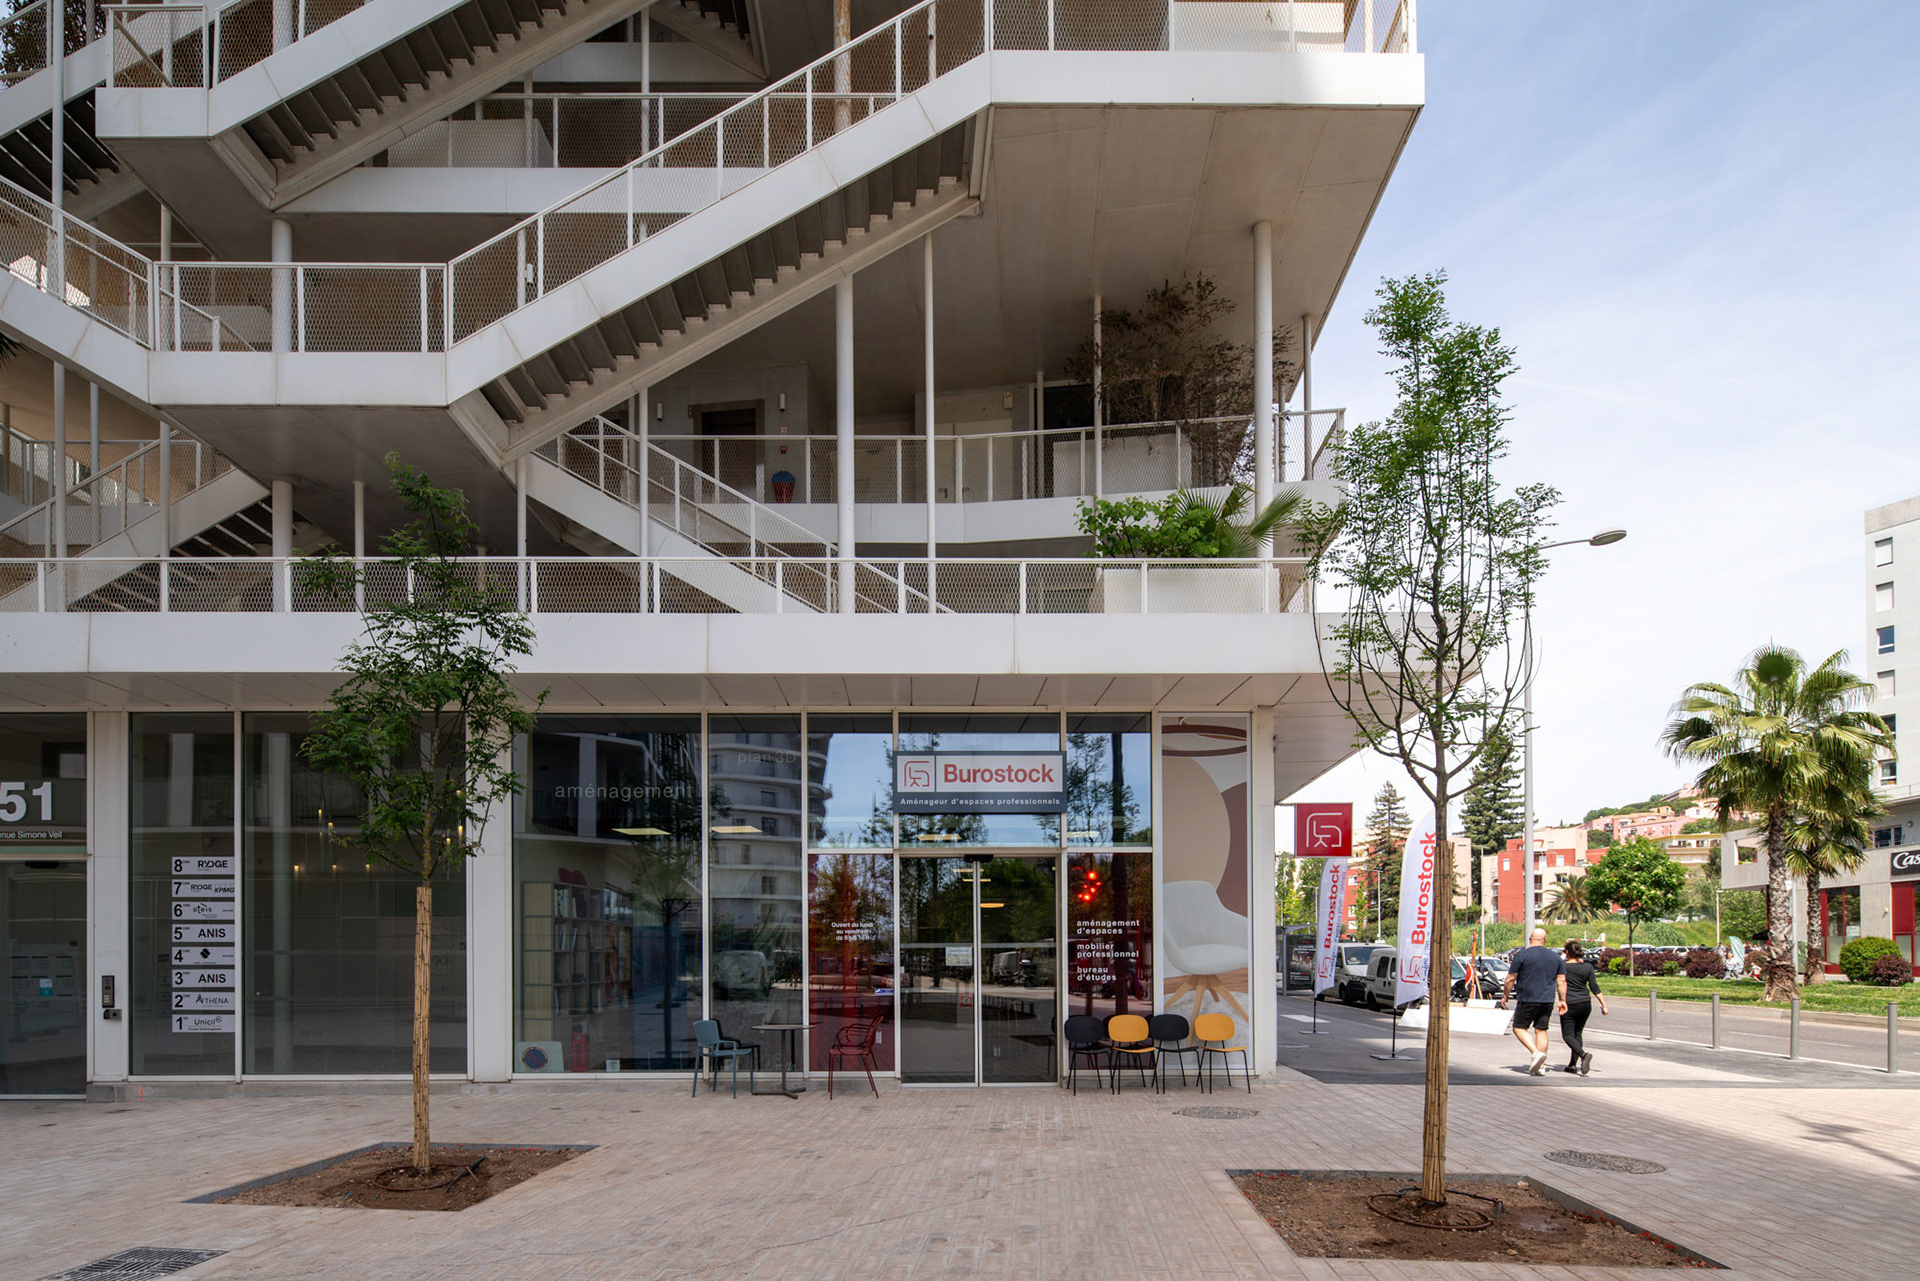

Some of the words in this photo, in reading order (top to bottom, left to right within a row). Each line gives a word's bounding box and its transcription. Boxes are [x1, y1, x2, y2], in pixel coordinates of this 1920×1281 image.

[737, 749, 771, 766] plan
[775, 750, 796, 764] 3D
[944, 763, 1054, 783] Burostock
[555, 783, 693, 802] aménagement
[0, 781, 52, 822] 51
[900, 798, 948, 807] Aménageur
[951, 798, 995, 807] d'espaces
[997, 798, 1060, 807] professionnels
[17, 830, 47, 839] Simone
[48, 830, 63, 839] Veil
[174, 859, 183, 873] 8
[197, 860, 228, 868] RYDGE
[173, 881, 182, 895] 7
[214, 886, 235, 894] KPMG
[1410, 832, 1436, 945] Burostock
[174, 903, 183, 917] 6
[1324, 864, 1340, 949] Burostock
[1076, 919, 1140, 928] aménagement
[174, 926, 183, 940] 5
[197, 928, 227, 938] ANIS
[1076, 927, 1123, 936] d'espaces
[1076, 942, 1114, 950] mobilier
[174, 949, 183, 963] 4
[1076, 950, 1139, 959] professionnel
[174, 971, 183, 985] 3
[198, 973, 227, 984] ANIS
[1076, 973, 1117, 981] d'études
[174, 994, 183, 1008] 2
[176, 1016, 182, 1030] 1
[194, 1018, 216, 1026] Unicil
